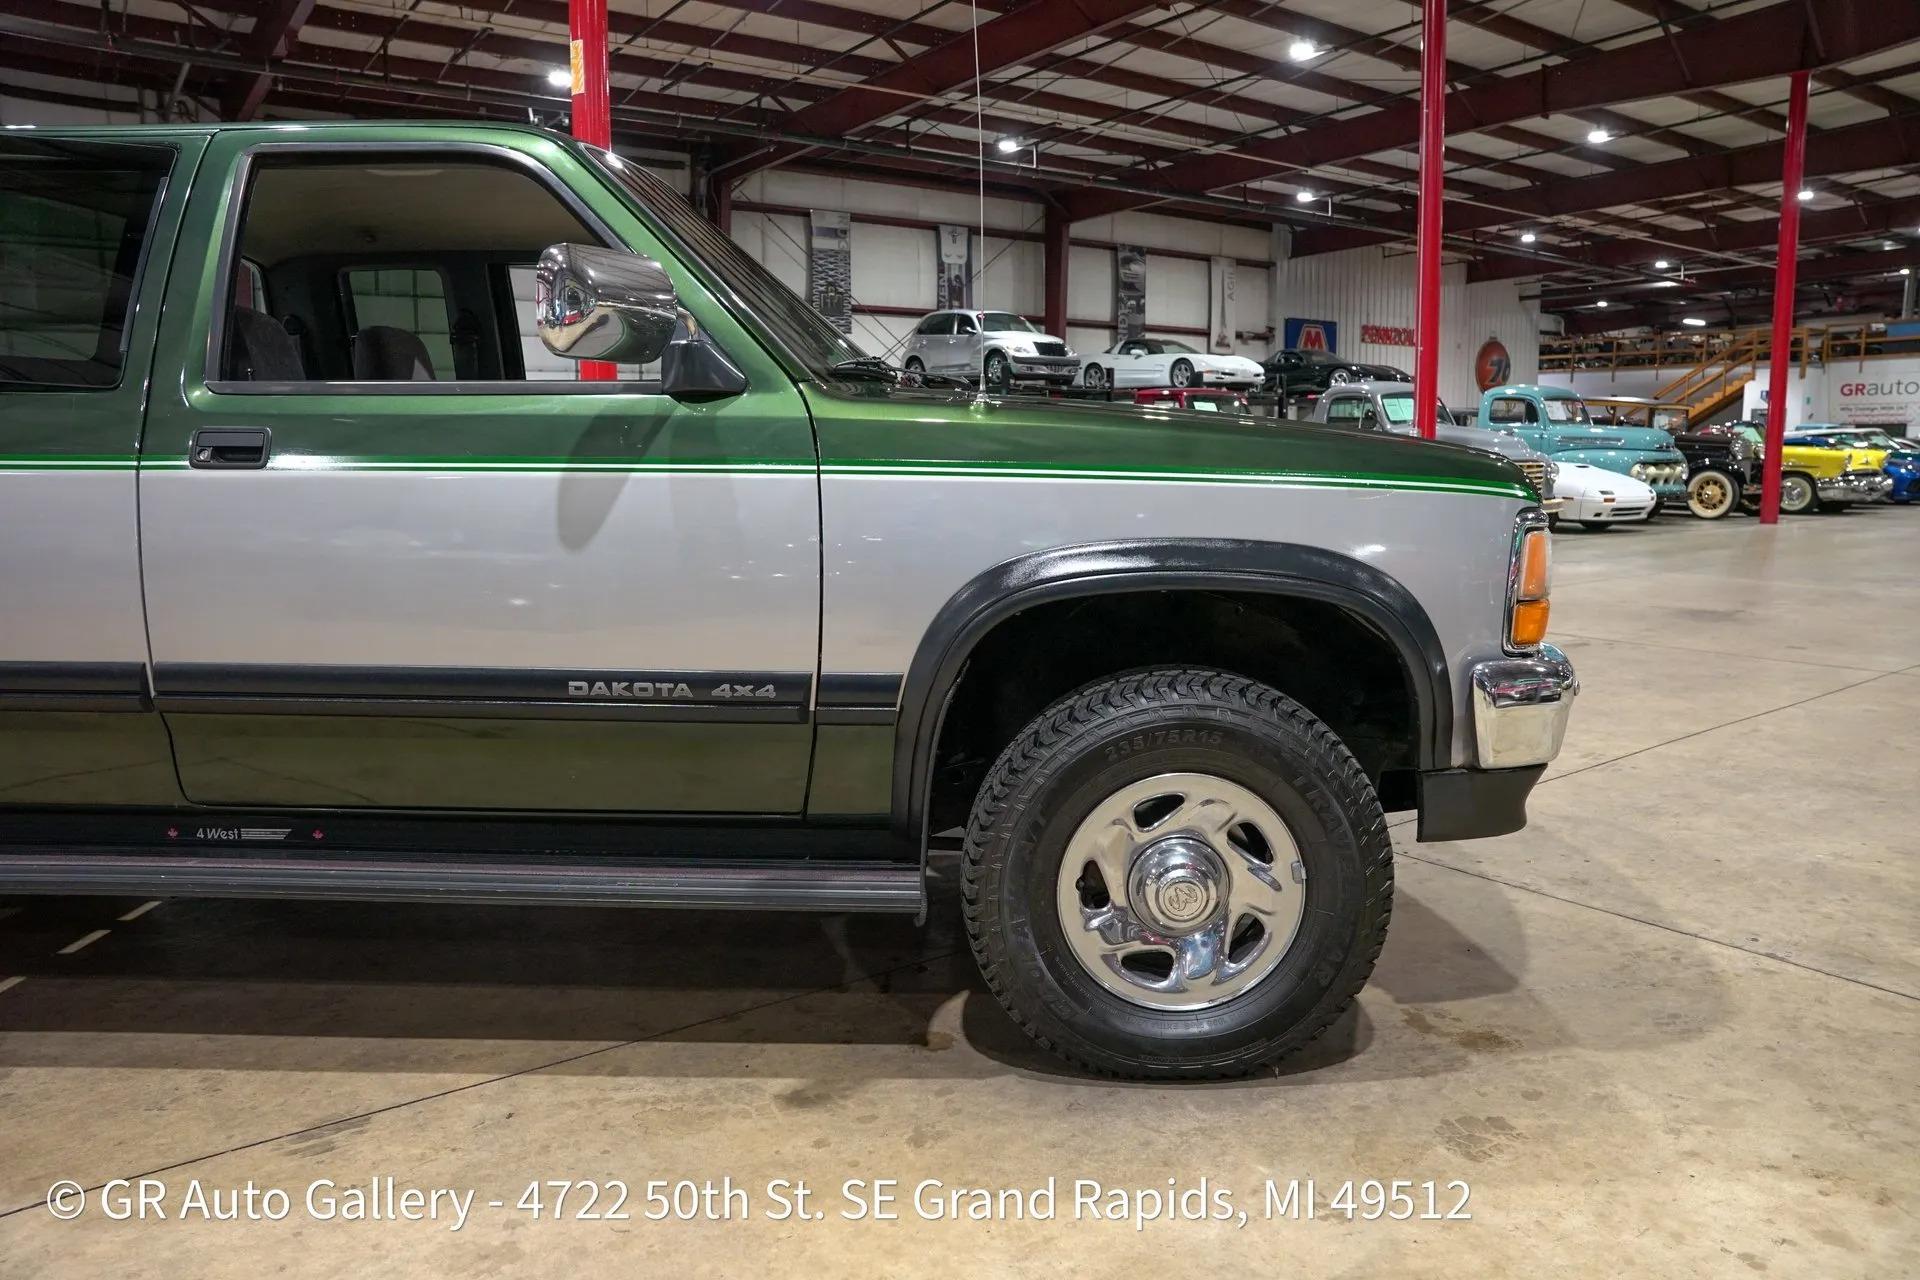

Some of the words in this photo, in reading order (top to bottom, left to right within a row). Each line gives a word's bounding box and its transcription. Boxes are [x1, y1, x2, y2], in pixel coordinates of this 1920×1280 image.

[567, 680, 694, 698] DAKOTA
[196, 827, 205, 840] 4
[206, 827, 239, 840] West
